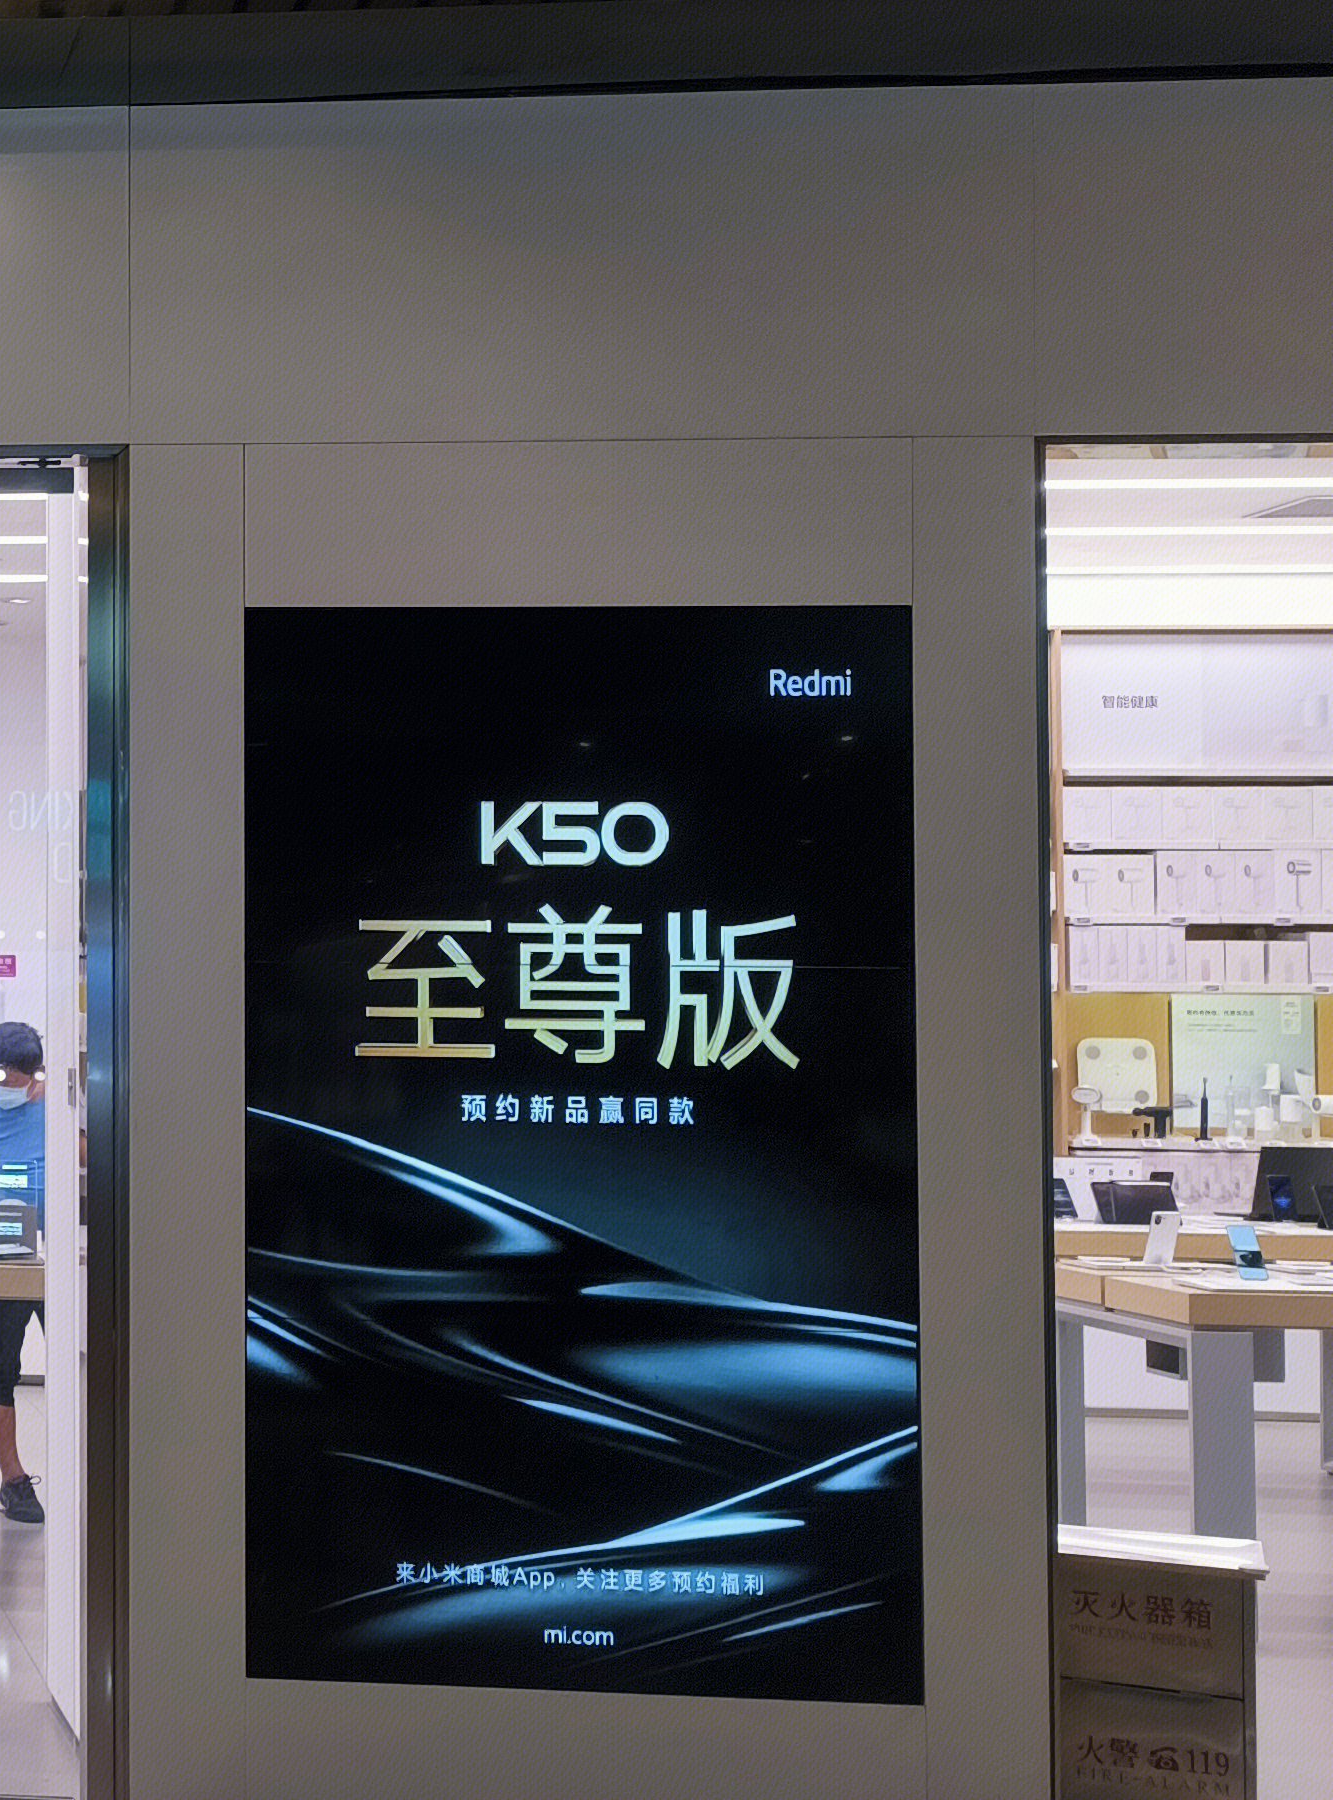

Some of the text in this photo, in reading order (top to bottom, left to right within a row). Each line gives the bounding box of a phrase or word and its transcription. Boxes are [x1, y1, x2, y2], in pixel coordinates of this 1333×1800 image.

[768, 668, 853, 699] Redmi
[480, 800, 670, 867] K50
[354, 903, 800, 1070] 至尊版
[460, 1094, 696, 1126] 预约新品赢同款
[1069, 1589, 1213, 1630] 灭火器箱
[543, 1626, 615, 1647] mi.com
[1186, 1749, 1231, 1777] 119
